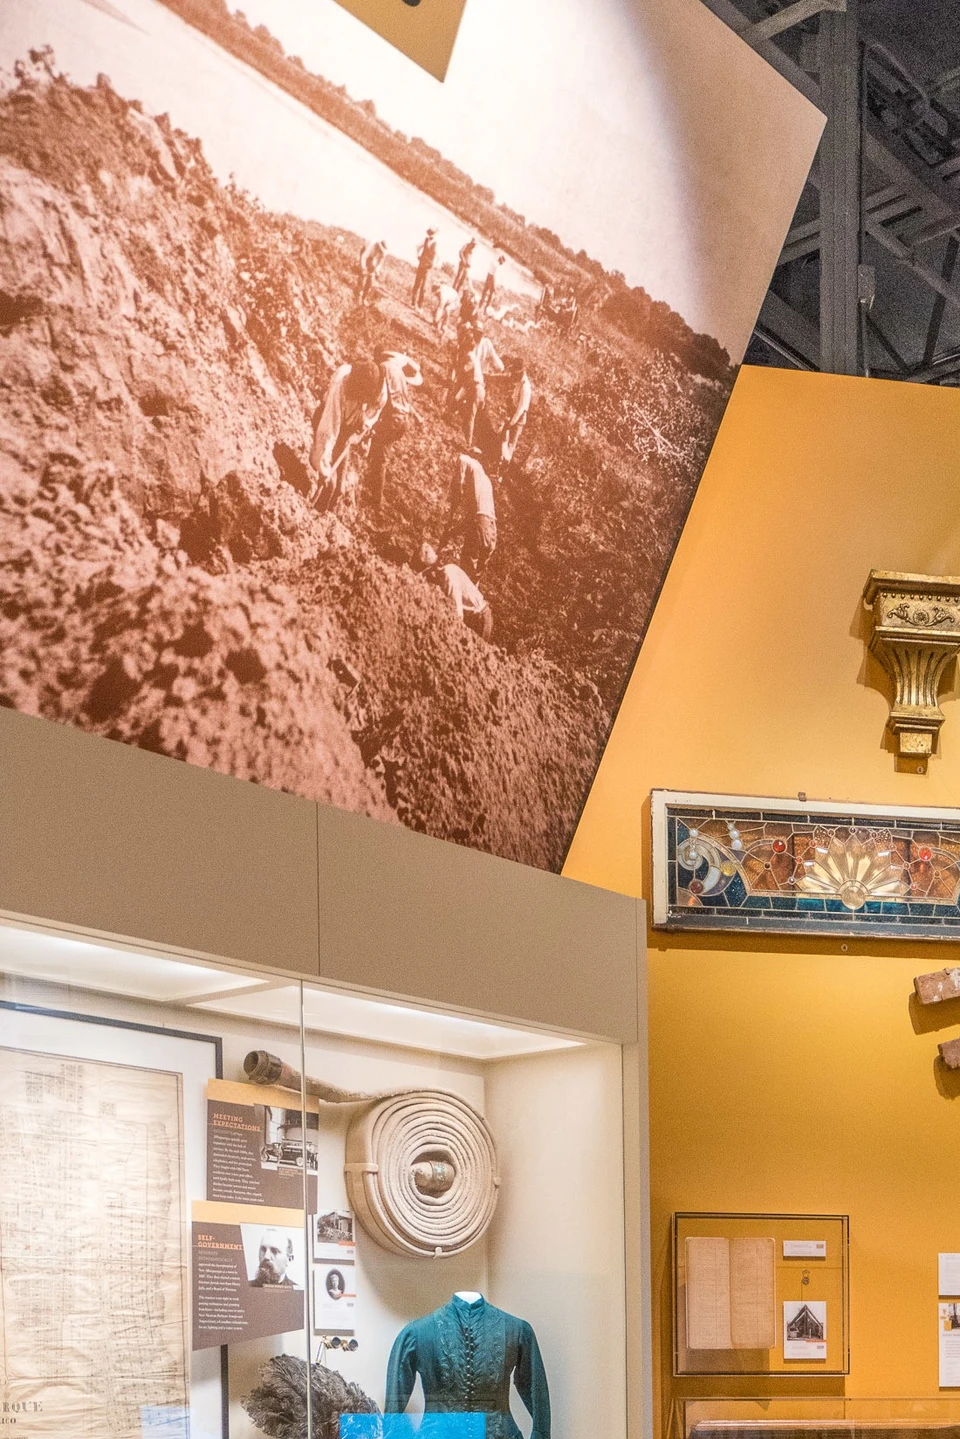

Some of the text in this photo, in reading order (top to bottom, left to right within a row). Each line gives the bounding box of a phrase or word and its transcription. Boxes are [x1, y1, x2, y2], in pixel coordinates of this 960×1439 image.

[213, 1113, 243, 1123] MEETING
[213, 1120, 260, 1132] EXPECTATIONS
[197, 1241, 243, 1250] GOVERNMENT
